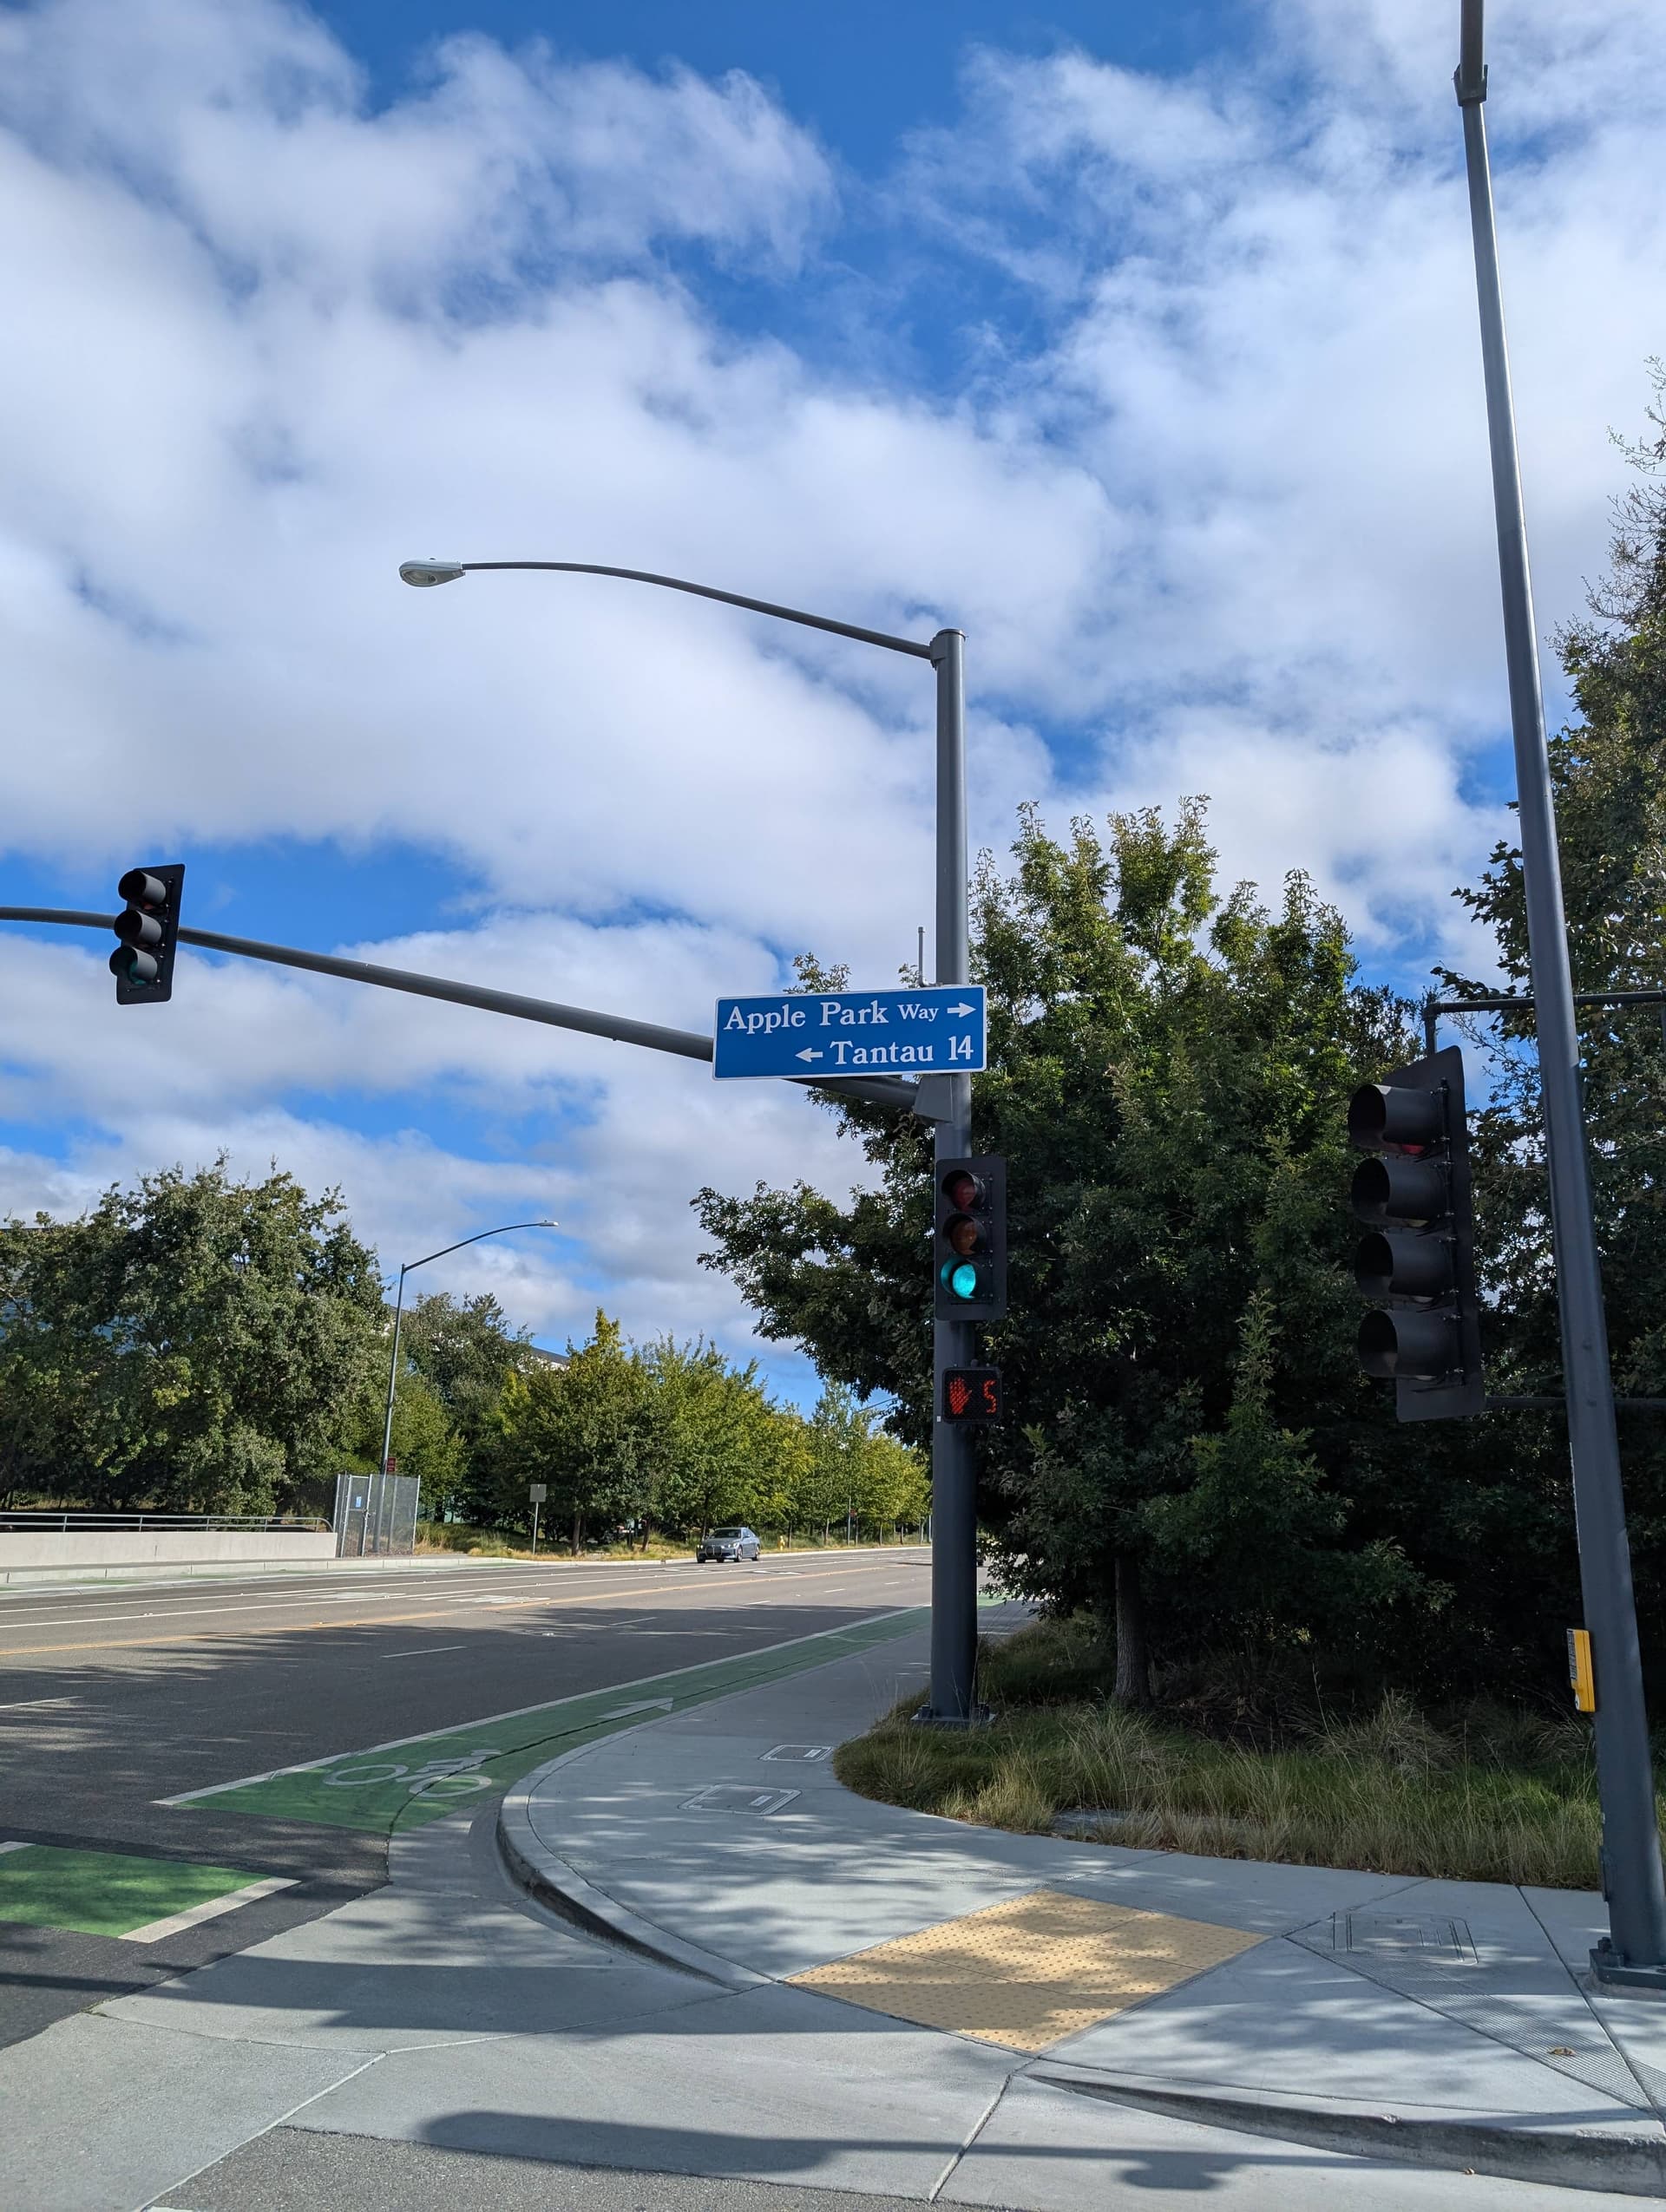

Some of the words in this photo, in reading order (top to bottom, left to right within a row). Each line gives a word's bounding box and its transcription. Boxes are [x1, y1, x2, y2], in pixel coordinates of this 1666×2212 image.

[724, 1004, 805, 1034] Apple
[819, 999, 889, 1026] Park
[897, 1004, 939, 1022] Way
[830, 1040, 934, 1065] Tantau
[948, 1035, 974, 1061] 14
[983, 1380, 996, 1413] 5
